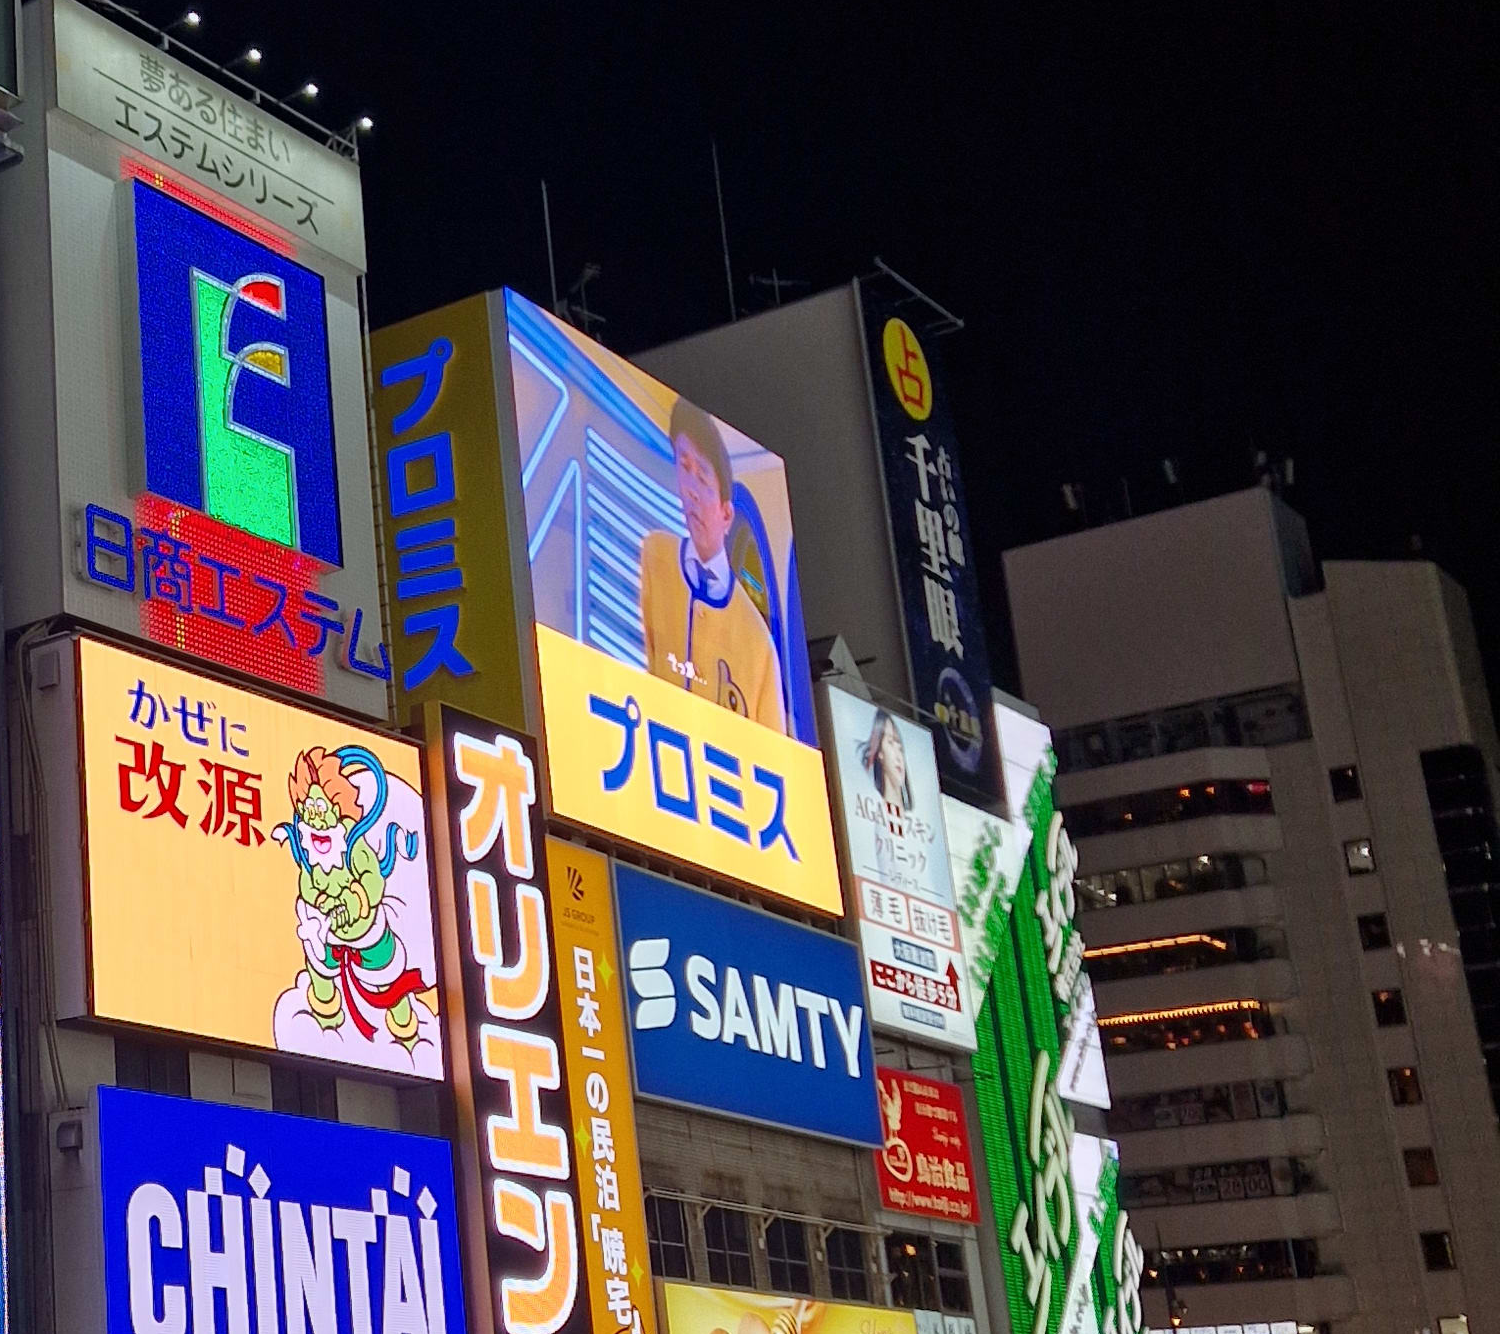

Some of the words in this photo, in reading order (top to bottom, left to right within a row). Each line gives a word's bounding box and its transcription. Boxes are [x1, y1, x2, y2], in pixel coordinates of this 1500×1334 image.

[115, 96, 318, 235] エステムシリーズ
[140, 53, 291, 164] 夢ある住まい
[381, 335, 475, 692] プロミス
[85, 502, 392, 682] 日商エステム
[127, 679, 250, 757] かぜに
[589, 693, 800, 862] プロミス
[115, 735, 265, 849] 改源
[875, 837, 927, 873] クリニック
[685, 955, 863, 1079] SAMTY
